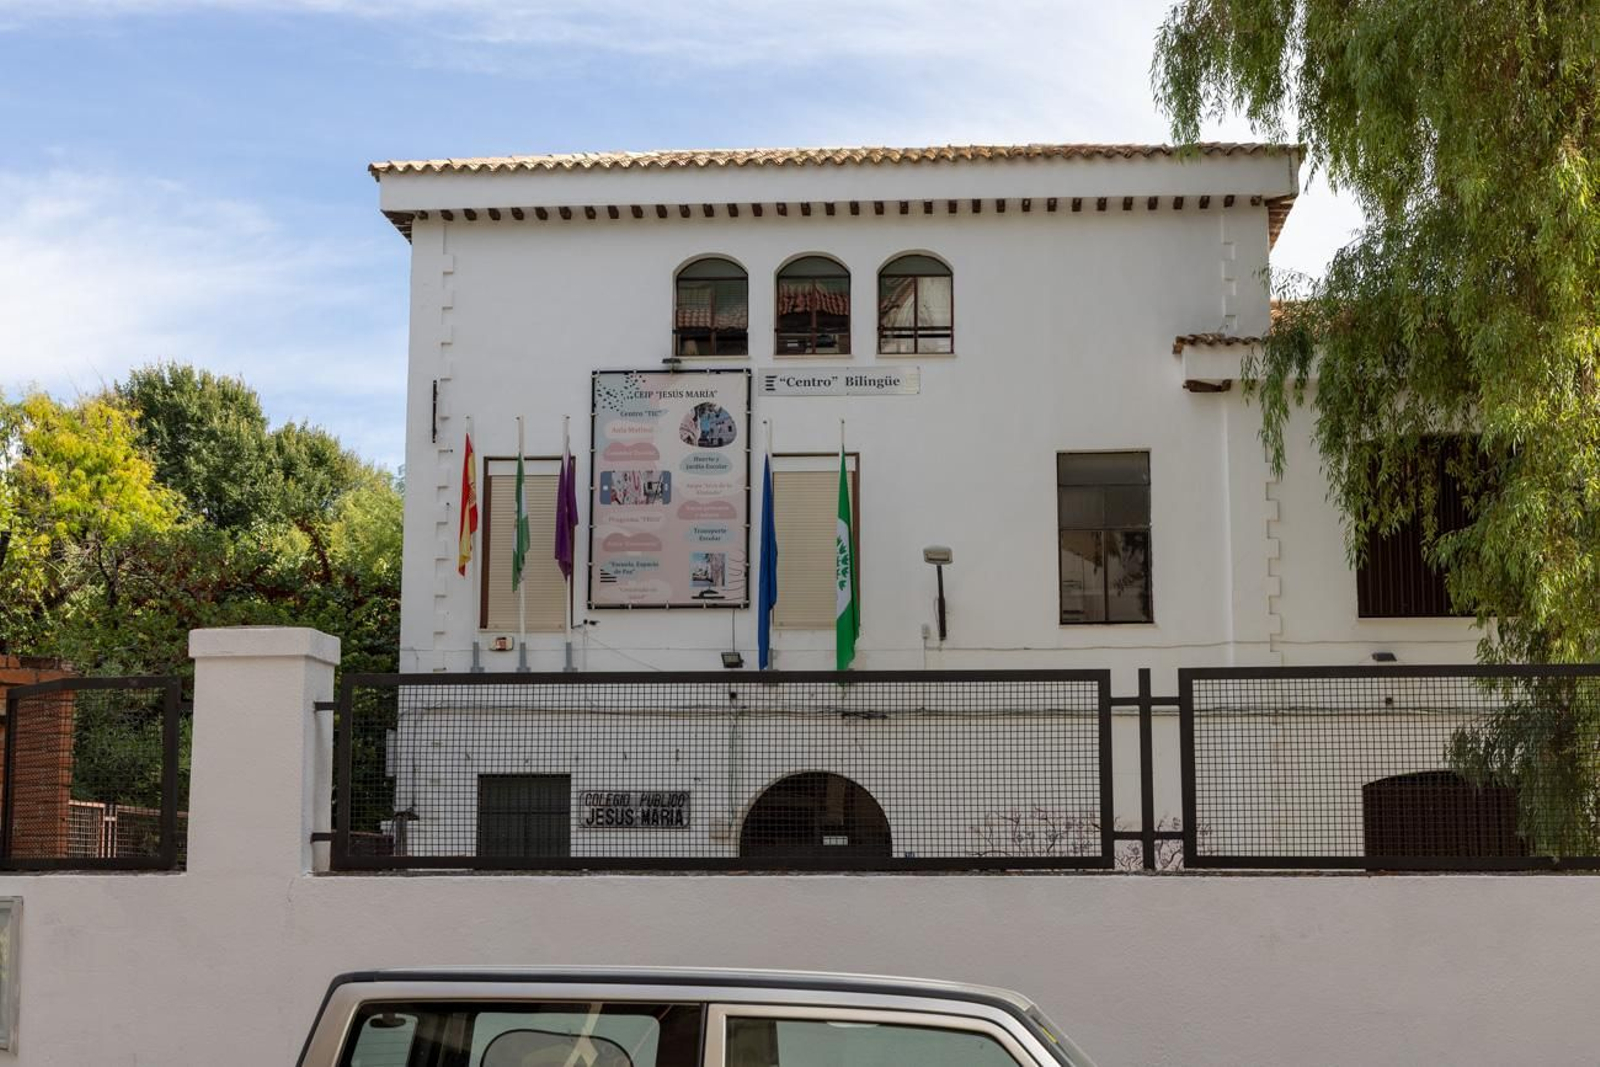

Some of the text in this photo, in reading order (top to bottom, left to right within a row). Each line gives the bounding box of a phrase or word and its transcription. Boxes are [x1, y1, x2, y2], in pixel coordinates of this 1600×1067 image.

[845, 375, 900, 389] Bilingüe
[633, 390, 654, 399] CEIP
[585, 793, 631, 807] COLEGIO
[586, 807, 684, 826] JESUS MARIA
